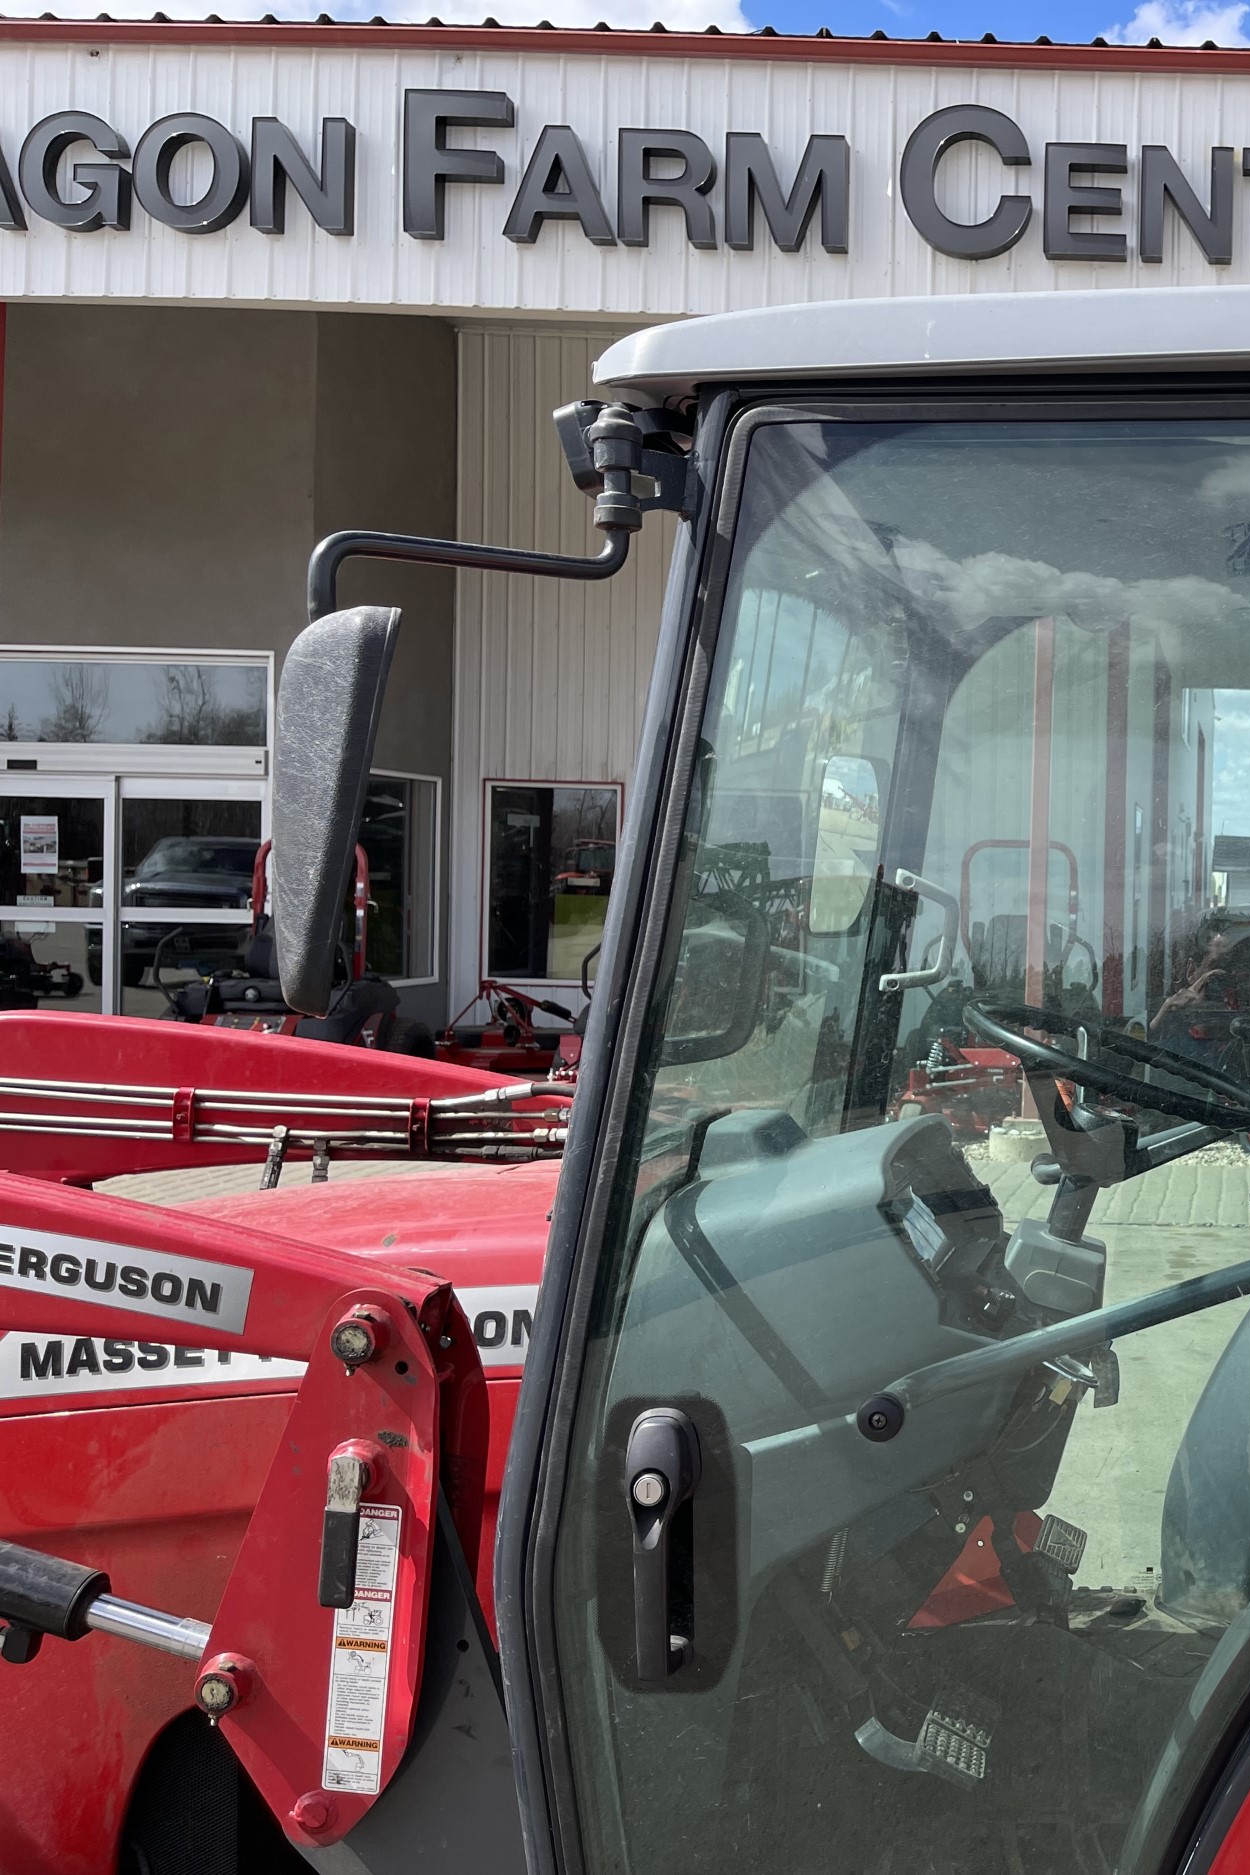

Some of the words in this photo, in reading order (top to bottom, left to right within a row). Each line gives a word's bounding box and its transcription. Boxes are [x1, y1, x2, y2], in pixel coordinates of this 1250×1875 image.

[0, 110, 355, 235] GON
[404, 88, 850, 255] FARM
[346, 1639, 386, 1650] WARNING
[338, 1738, 378, 1749] WARNING
